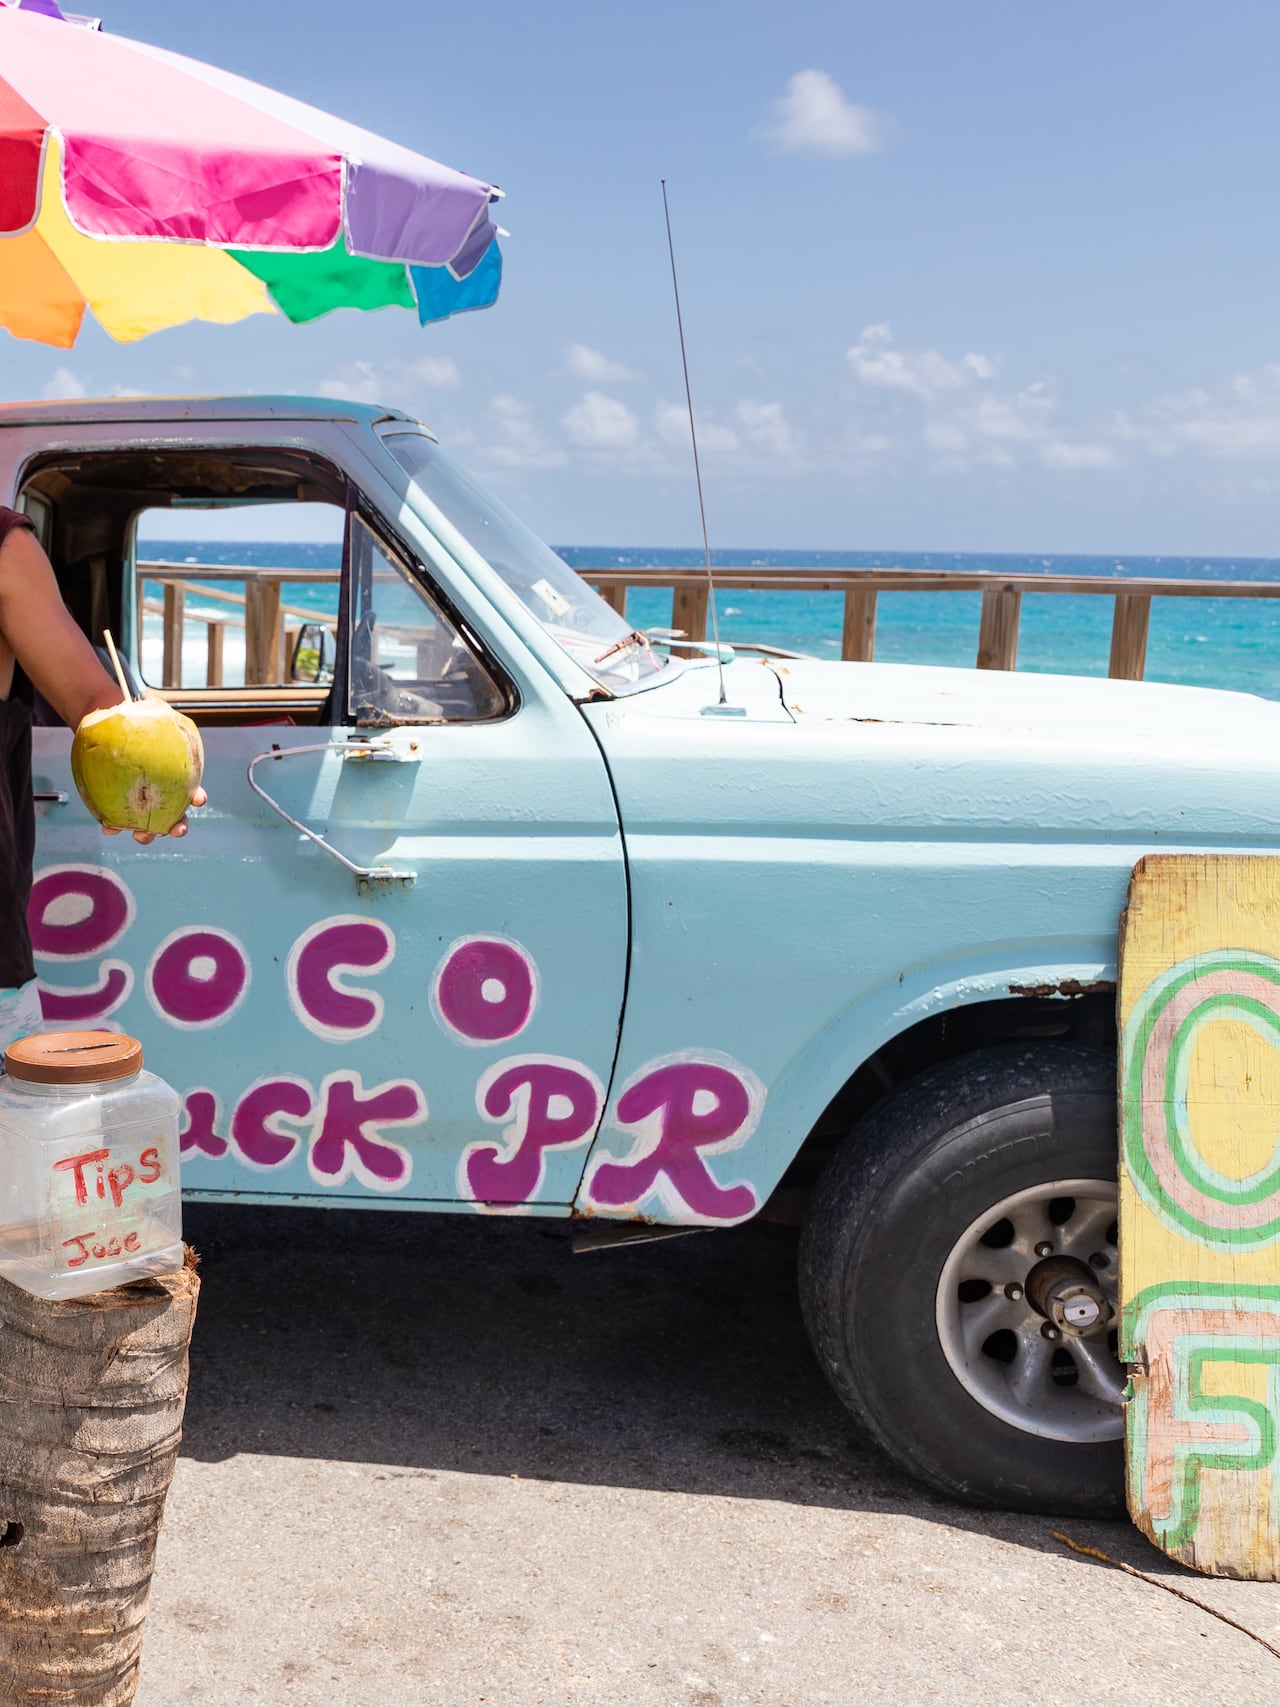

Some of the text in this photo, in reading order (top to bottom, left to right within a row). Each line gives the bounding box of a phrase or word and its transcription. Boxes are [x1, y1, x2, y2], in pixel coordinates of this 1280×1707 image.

[457, 1052, 768, 1227] PR
[52, 1147, 162, 1208] Tips
[61, 1231, 142, 1267] Jose
